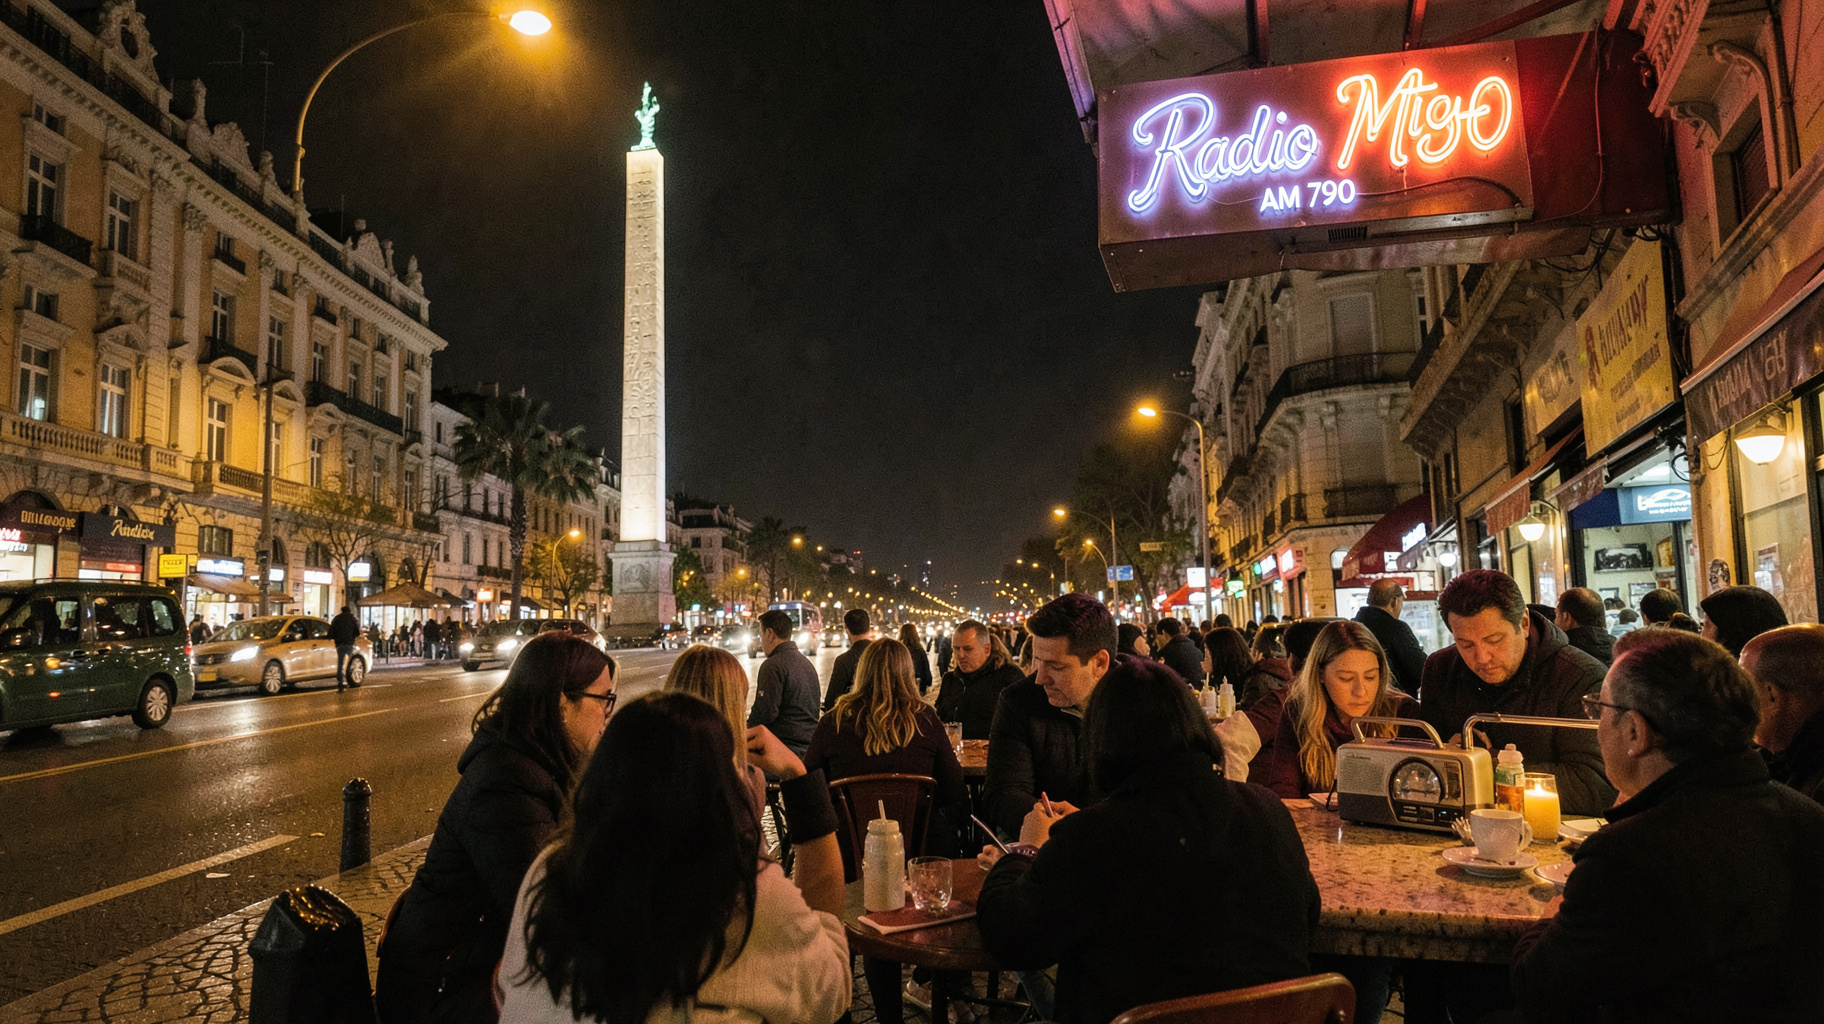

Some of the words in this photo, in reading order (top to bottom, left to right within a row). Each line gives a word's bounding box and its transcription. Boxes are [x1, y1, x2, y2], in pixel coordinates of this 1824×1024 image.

[1128, 92, 1319, 212] Radio
[1259, 184, 1301, 212] AM
[1306, 178, 1356, 208] 790
